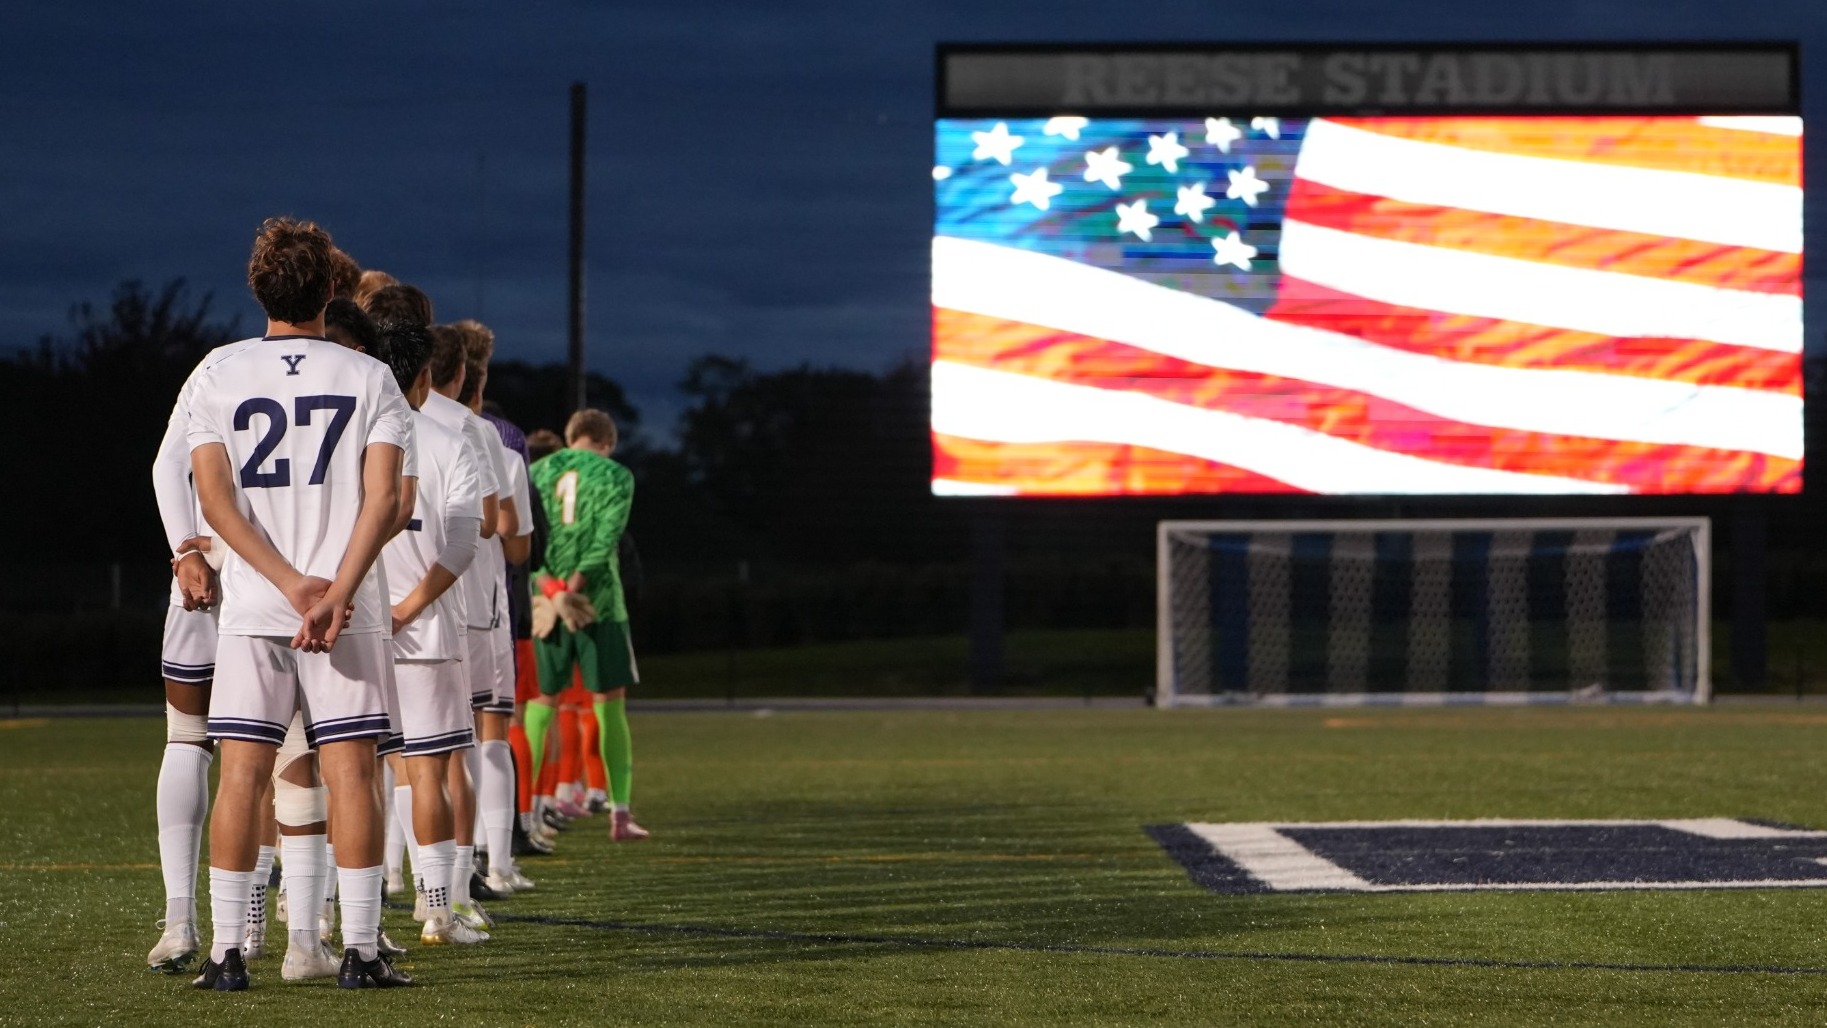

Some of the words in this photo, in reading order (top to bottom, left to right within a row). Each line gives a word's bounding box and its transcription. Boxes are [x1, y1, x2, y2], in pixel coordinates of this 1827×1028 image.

[1063, 54, 1300, 105] REESE
[1324, 54, 1676, 106] STADIUM
[281, 355, 306, 376] Y
[233, 395, 357, 488] 27
[554, 470, 579, 526] 1
